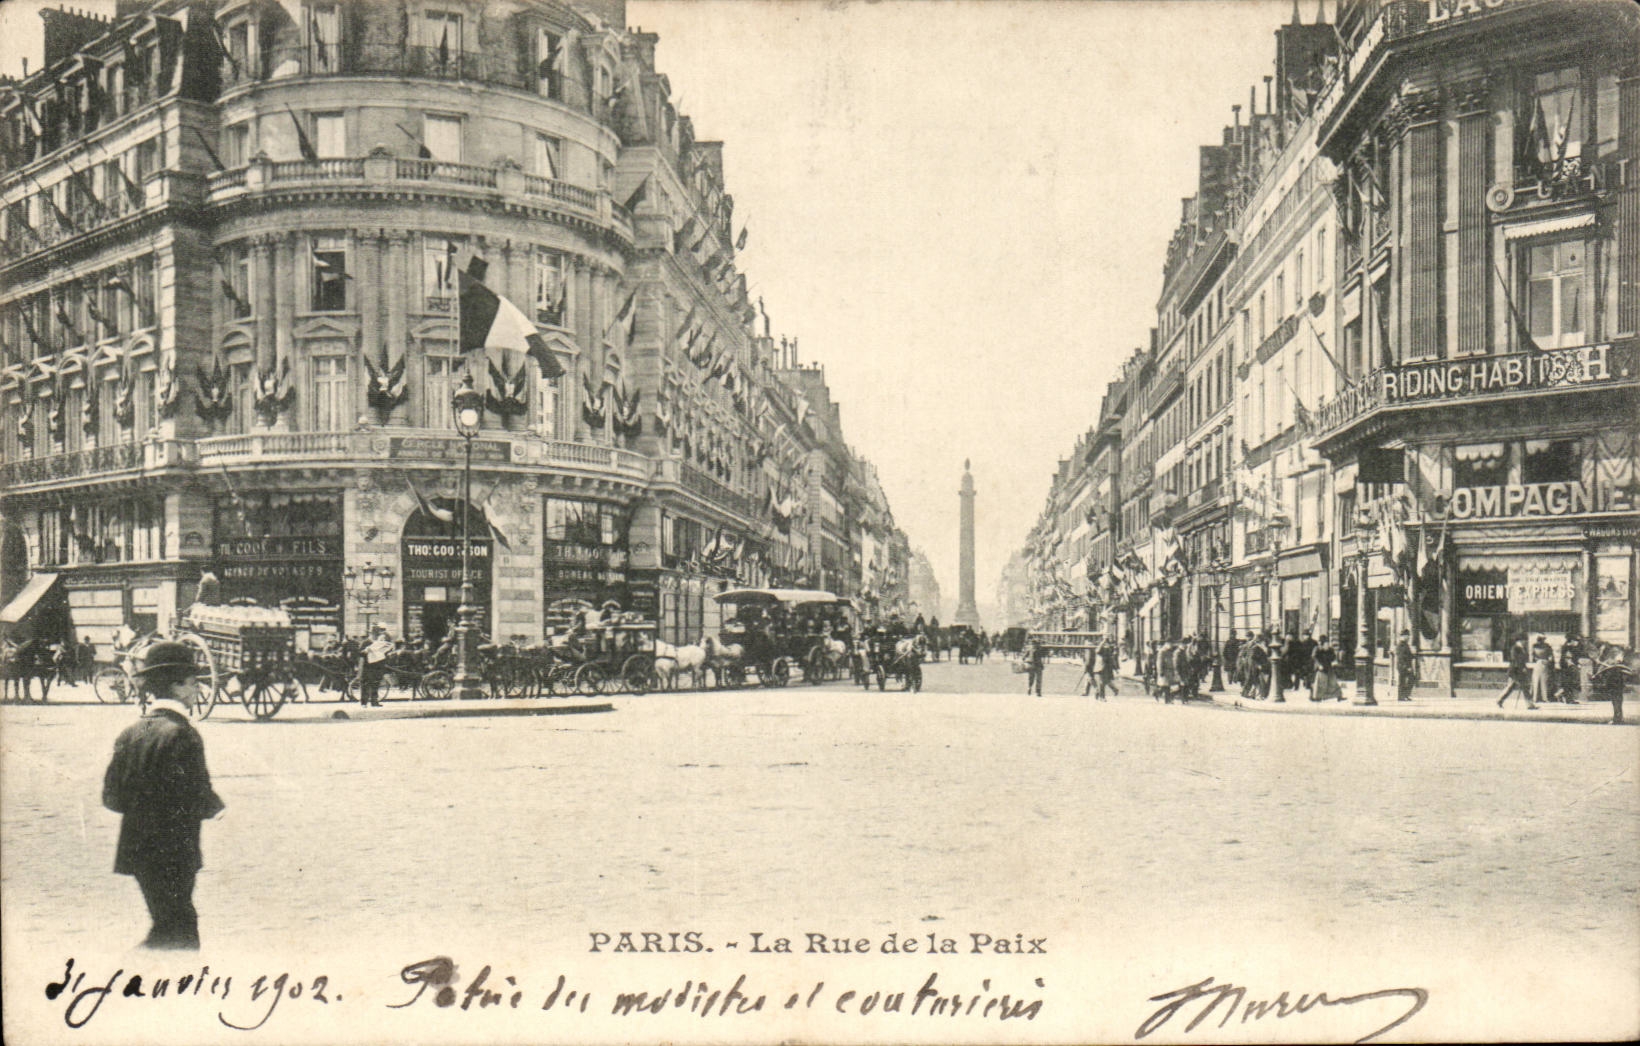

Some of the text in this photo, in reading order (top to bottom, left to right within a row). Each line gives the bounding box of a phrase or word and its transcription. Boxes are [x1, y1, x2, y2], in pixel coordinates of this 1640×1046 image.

[1382, 353, 1567, 399] RIDING HABITS
[1428, 480, 1631, 519] COMPAGNIE
[410, 569, 448, 579] TOURIST
[1465, 584, 1511, 600] ORIENT
